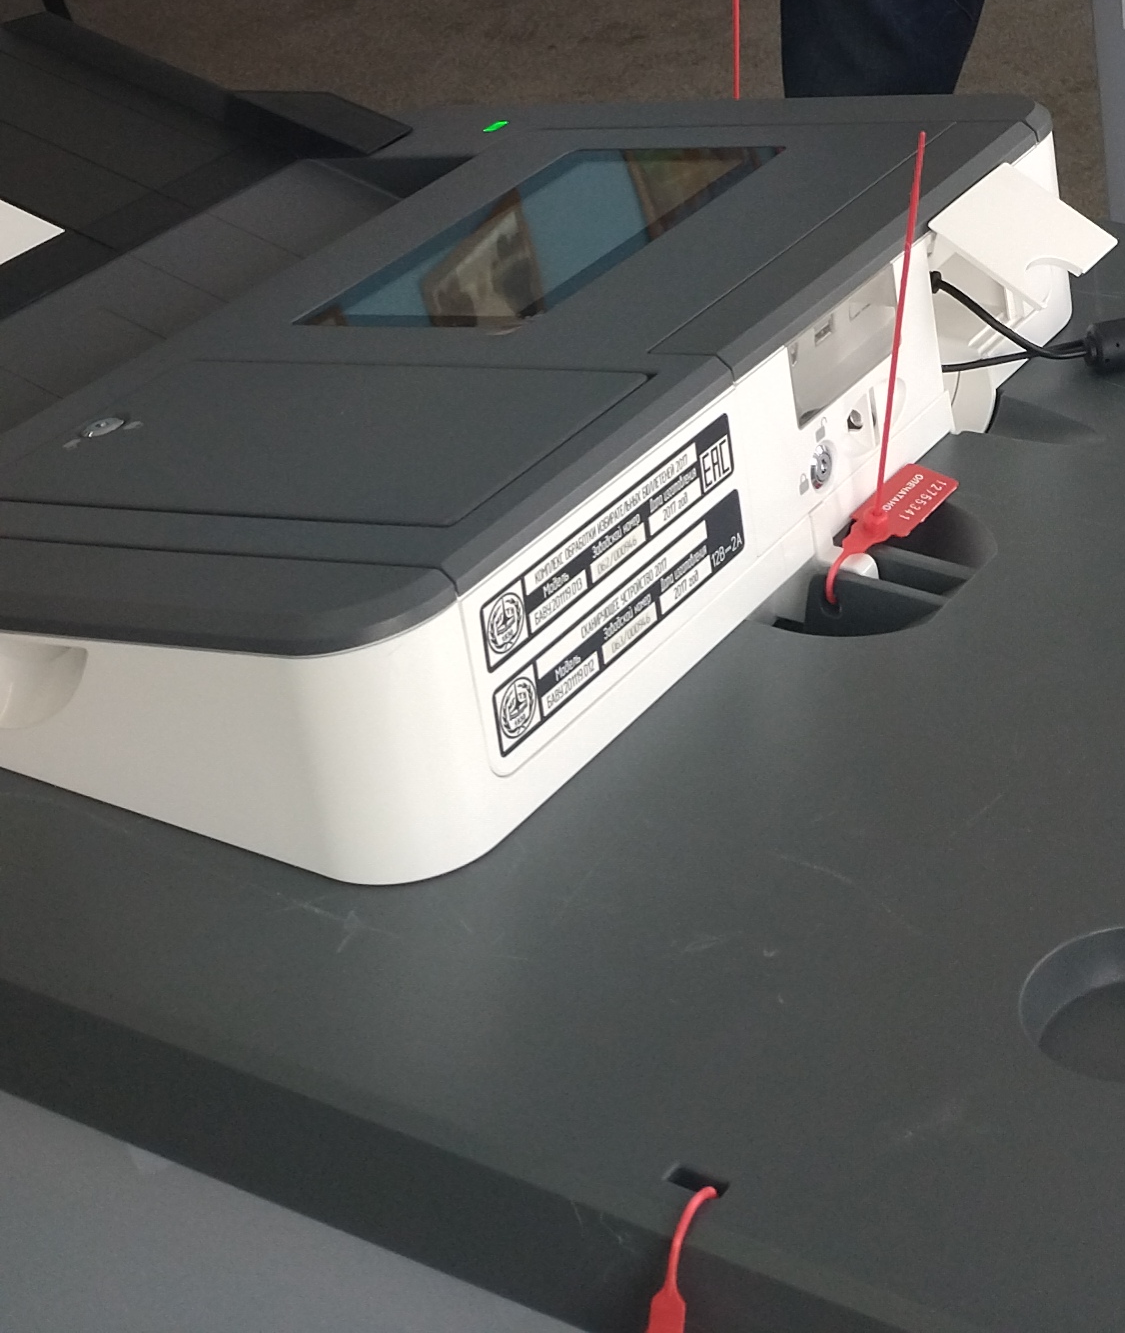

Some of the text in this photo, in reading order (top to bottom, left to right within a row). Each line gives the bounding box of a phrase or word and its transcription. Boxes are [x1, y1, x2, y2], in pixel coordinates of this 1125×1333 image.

[701, 440, 729, 488] EAC
[534, 553, 563, 585] КОМПЛЕКС
[564, 527, 596, 561] ОБРАБОТКИ
[597, 491, 641, 535] ИЗБИРАТЕЛЬНЫХ
[642, 464, 675, 499] БЮЛЛЕТЕНЕЙ
[663, 502, 676, 521] 2017
[899, 480, 947, 520] 12755341
[543, 568, 569, 599] Модель
[591, 527, 621, 560] Заводской
[623, 513, 640, 536] номер
[663, 466, 697, 502] изготовления
[554, 650, 581, 681] Модель
[603, 607, 632, 641] Заводской
[634, 593, 651, 616] номер
[674, 544, 707, 581] изготовления
[580, 598, 619, 639] СКАНИРУЮЩЕЕ
[619, 569, 654, 606] УСТРОЙСТВО
[673, 580, 687, 600] 2017
